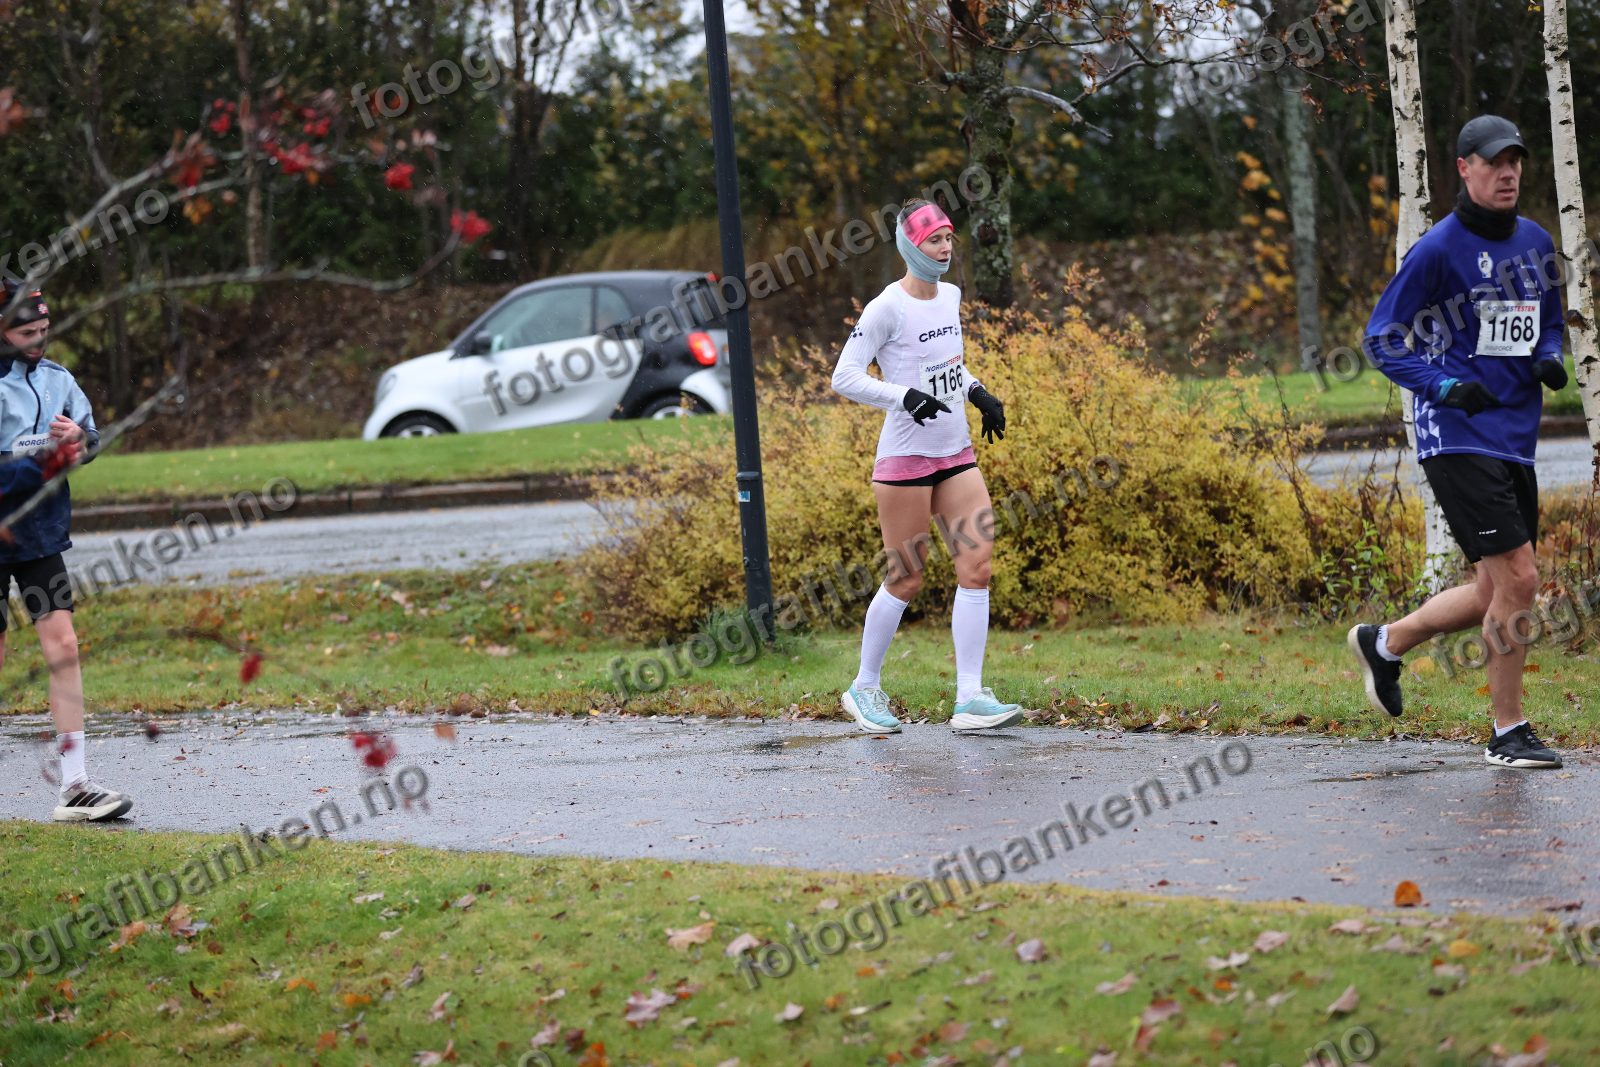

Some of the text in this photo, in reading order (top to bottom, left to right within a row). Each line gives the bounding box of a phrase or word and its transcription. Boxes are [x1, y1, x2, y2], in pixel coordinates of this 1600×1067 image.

[919, 326, 953, 342] CRAFT
[1488, 316, 1534, 342] 1168
[929, 365, 962, 396] 1166
